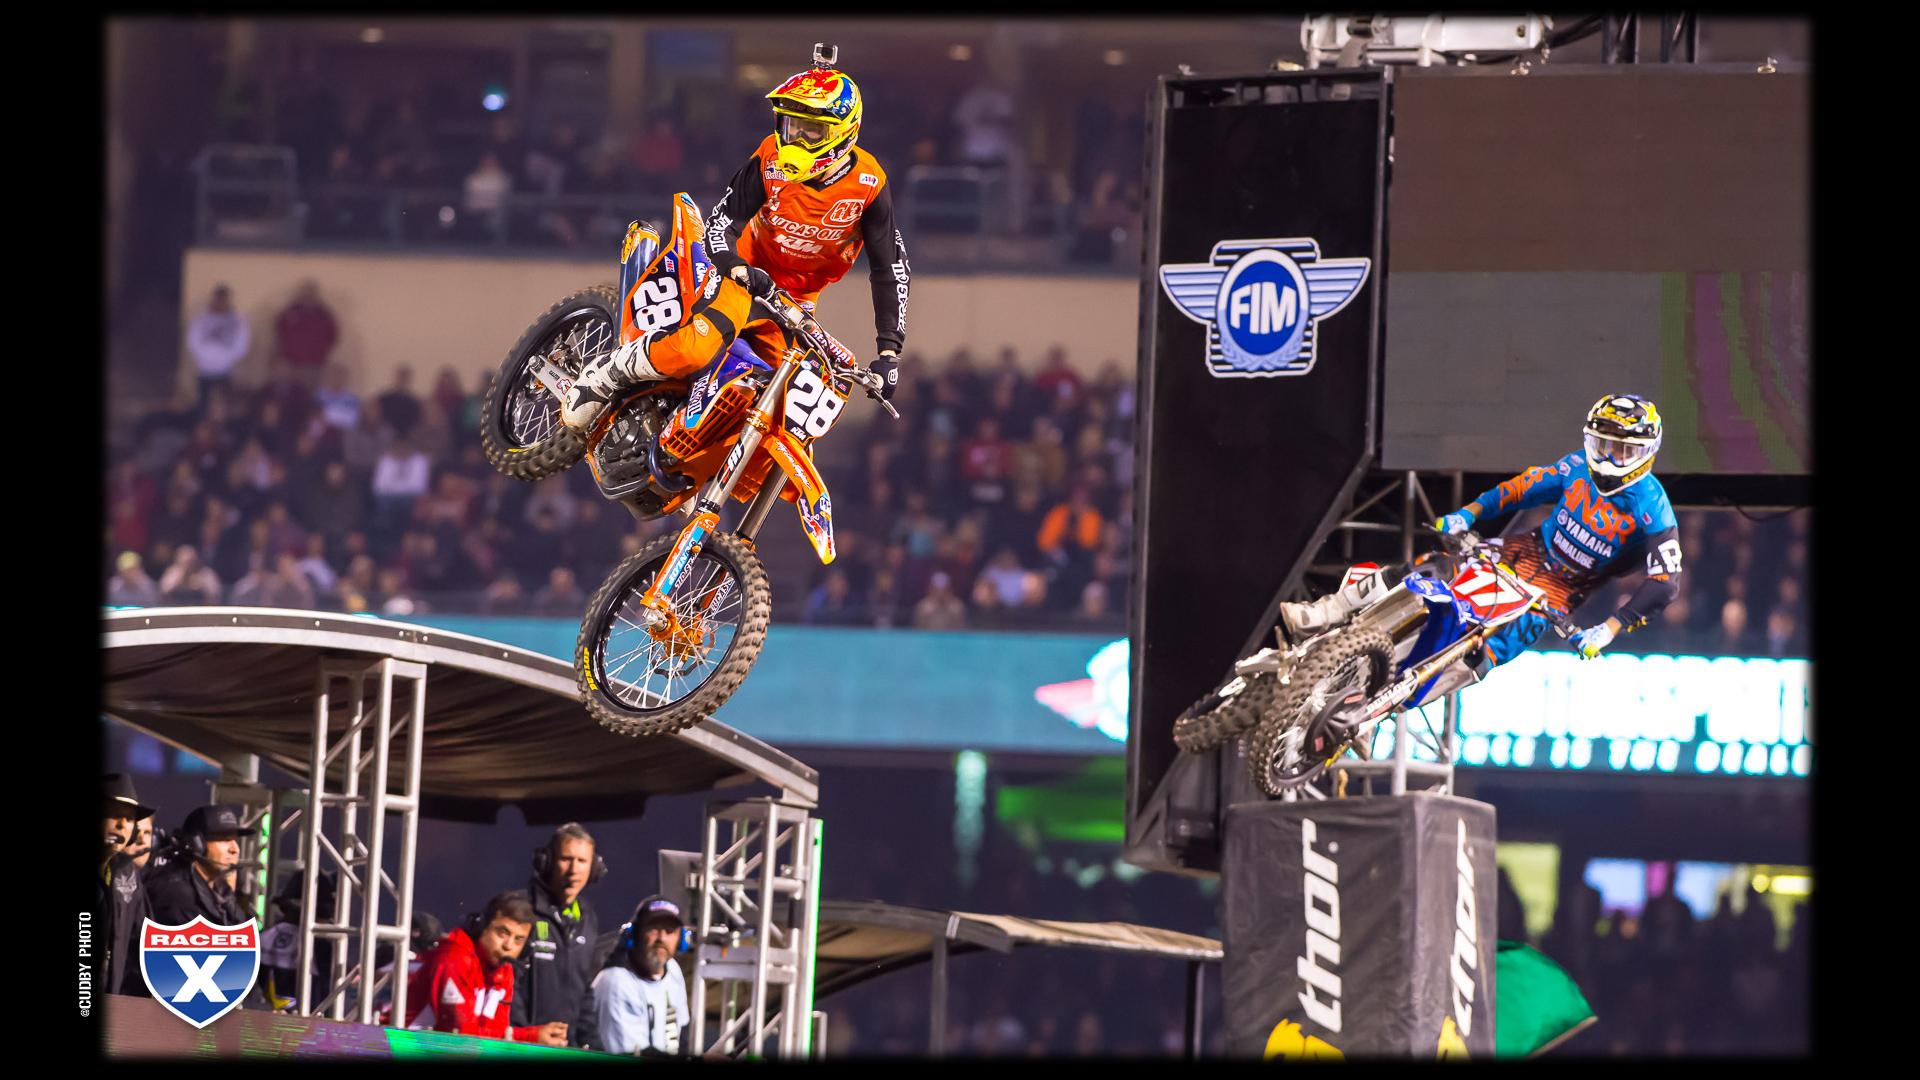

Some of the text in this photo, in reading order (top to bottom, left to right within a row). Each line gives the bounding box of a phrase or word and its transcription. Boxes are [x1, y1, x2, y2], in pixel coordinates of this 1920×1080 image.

[771, 215, 845, 241] LUCAS OIL
[774, 234, 823, 254] KTM
[633, 276, 682, 332] 28
[1230, 281, 1297, 335] FIM
[785, 369, 845, 437] 28
[790, 426, 808, 440] KTM
[1564, 477, 1637, 545] ANSR
[1553, 529, 1596, 569] YAMALUBE
[1566, 517, 1613, 558] YAMAHA
[1454, 569, 1524, 607] 17
[583, 646, 598, 691] DUNLOP
